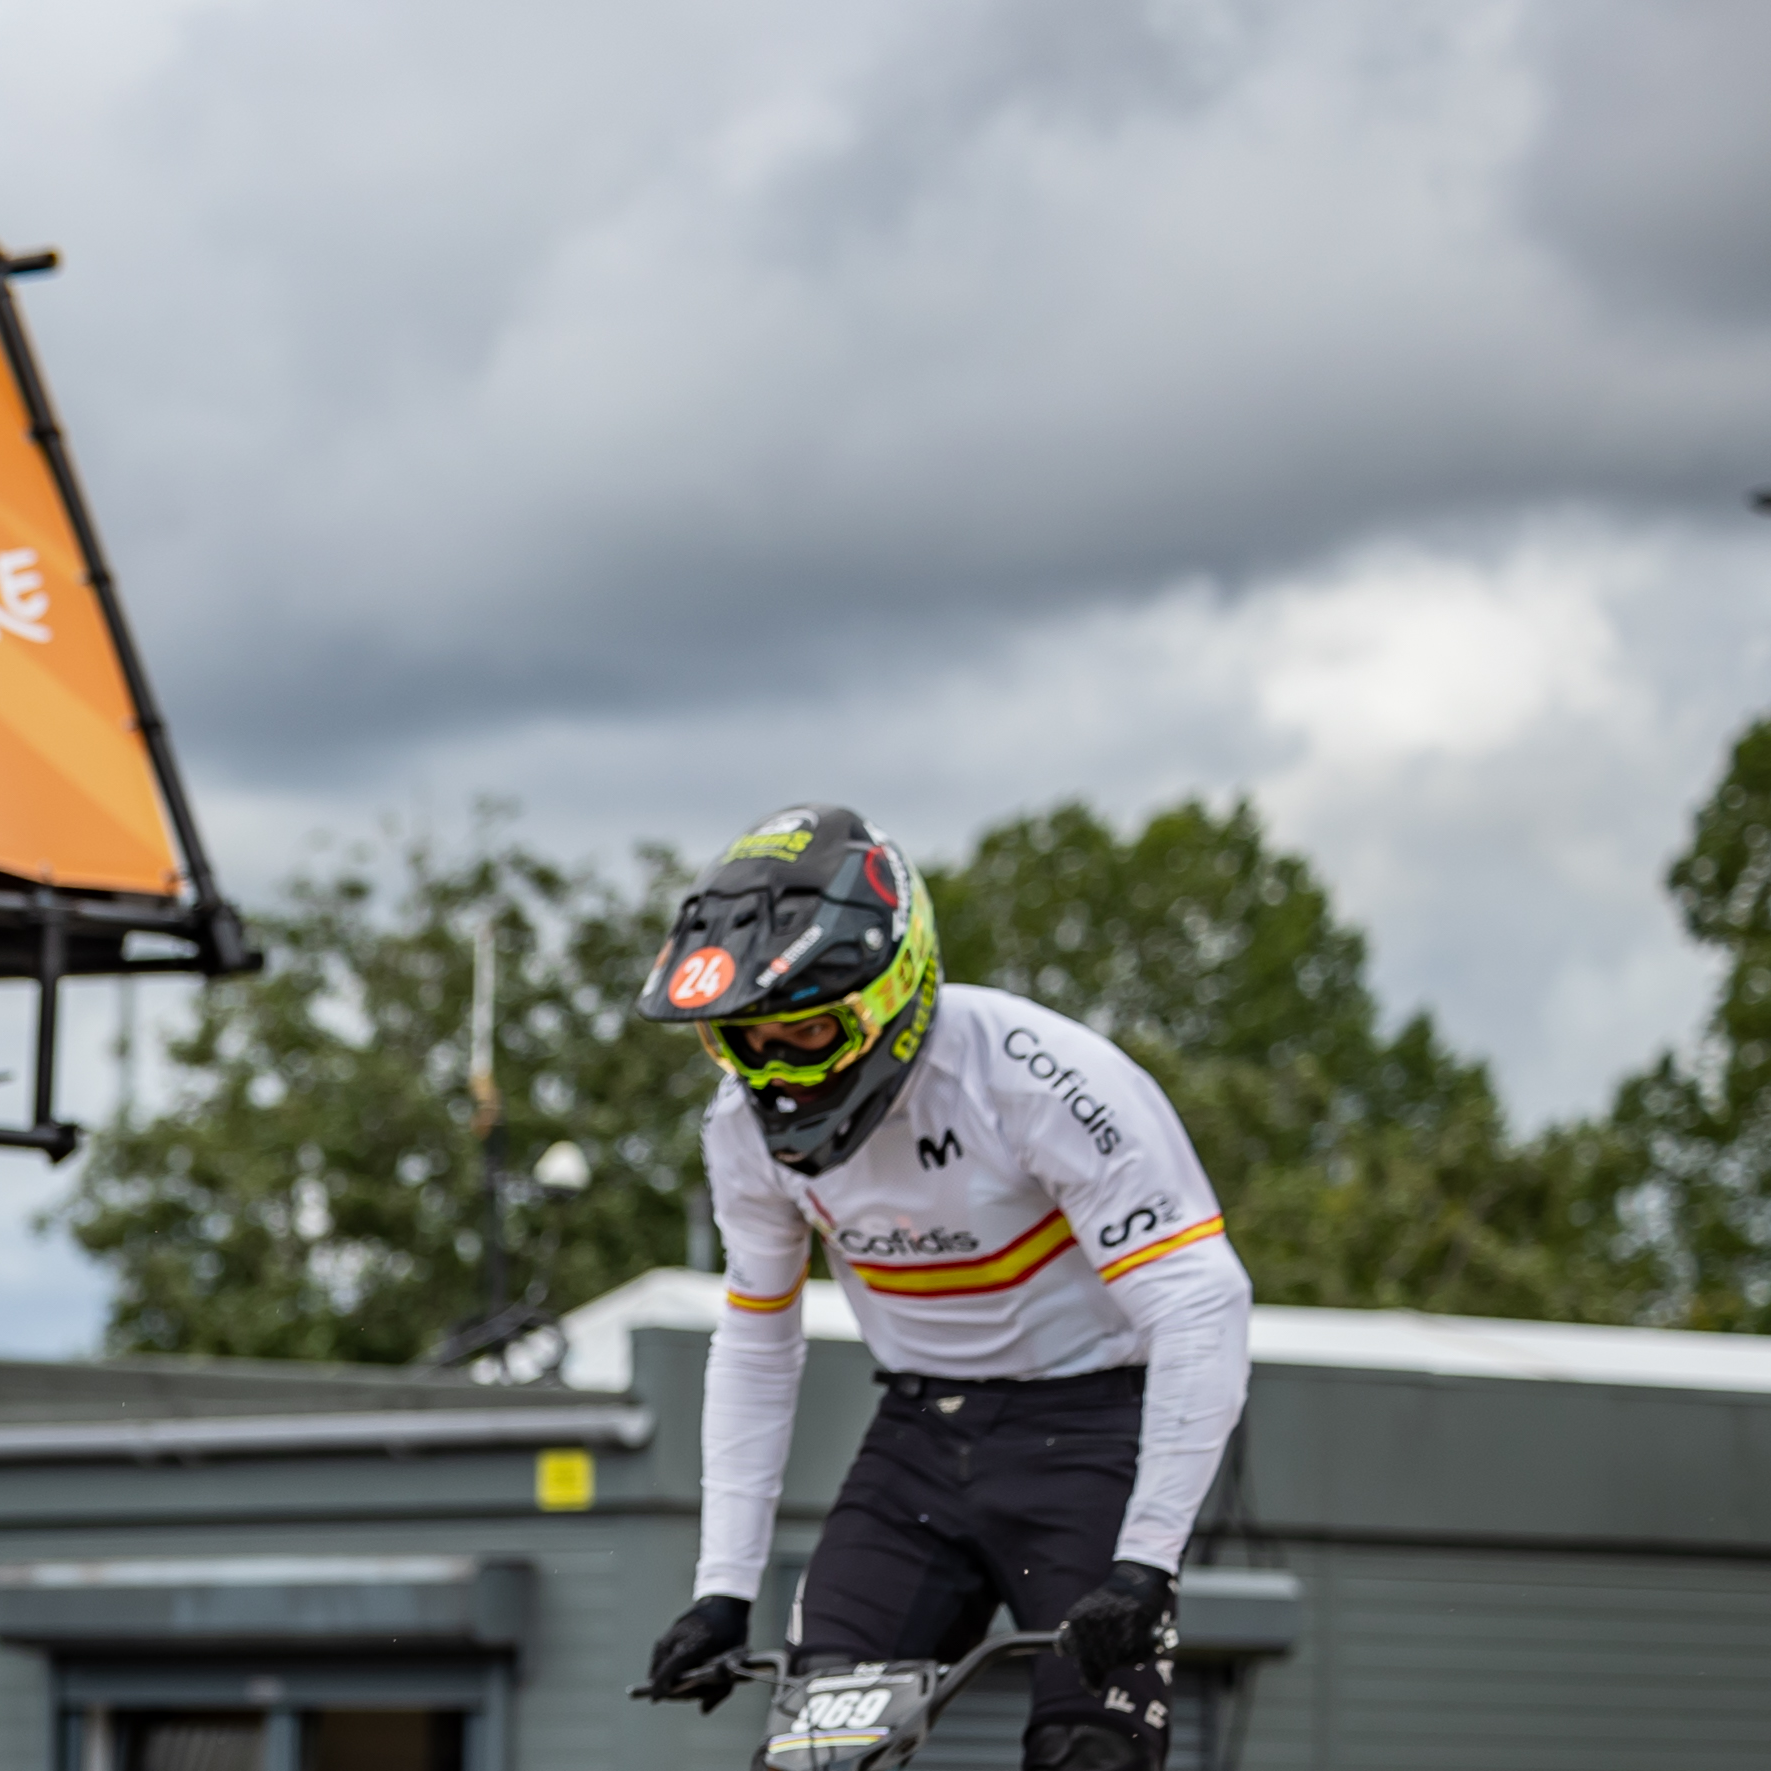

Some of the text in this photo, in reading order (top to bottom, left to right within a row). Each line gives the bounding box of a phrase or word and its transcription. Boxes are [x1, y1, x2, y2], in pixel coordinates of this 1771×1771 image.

[674, 954, 724, 1001] 24
[1003, 1026, 1124, 1158] Cofidis
[838, 1224, 980, 1257] Cofidis
[790, 1686, 894, 1735] 969
